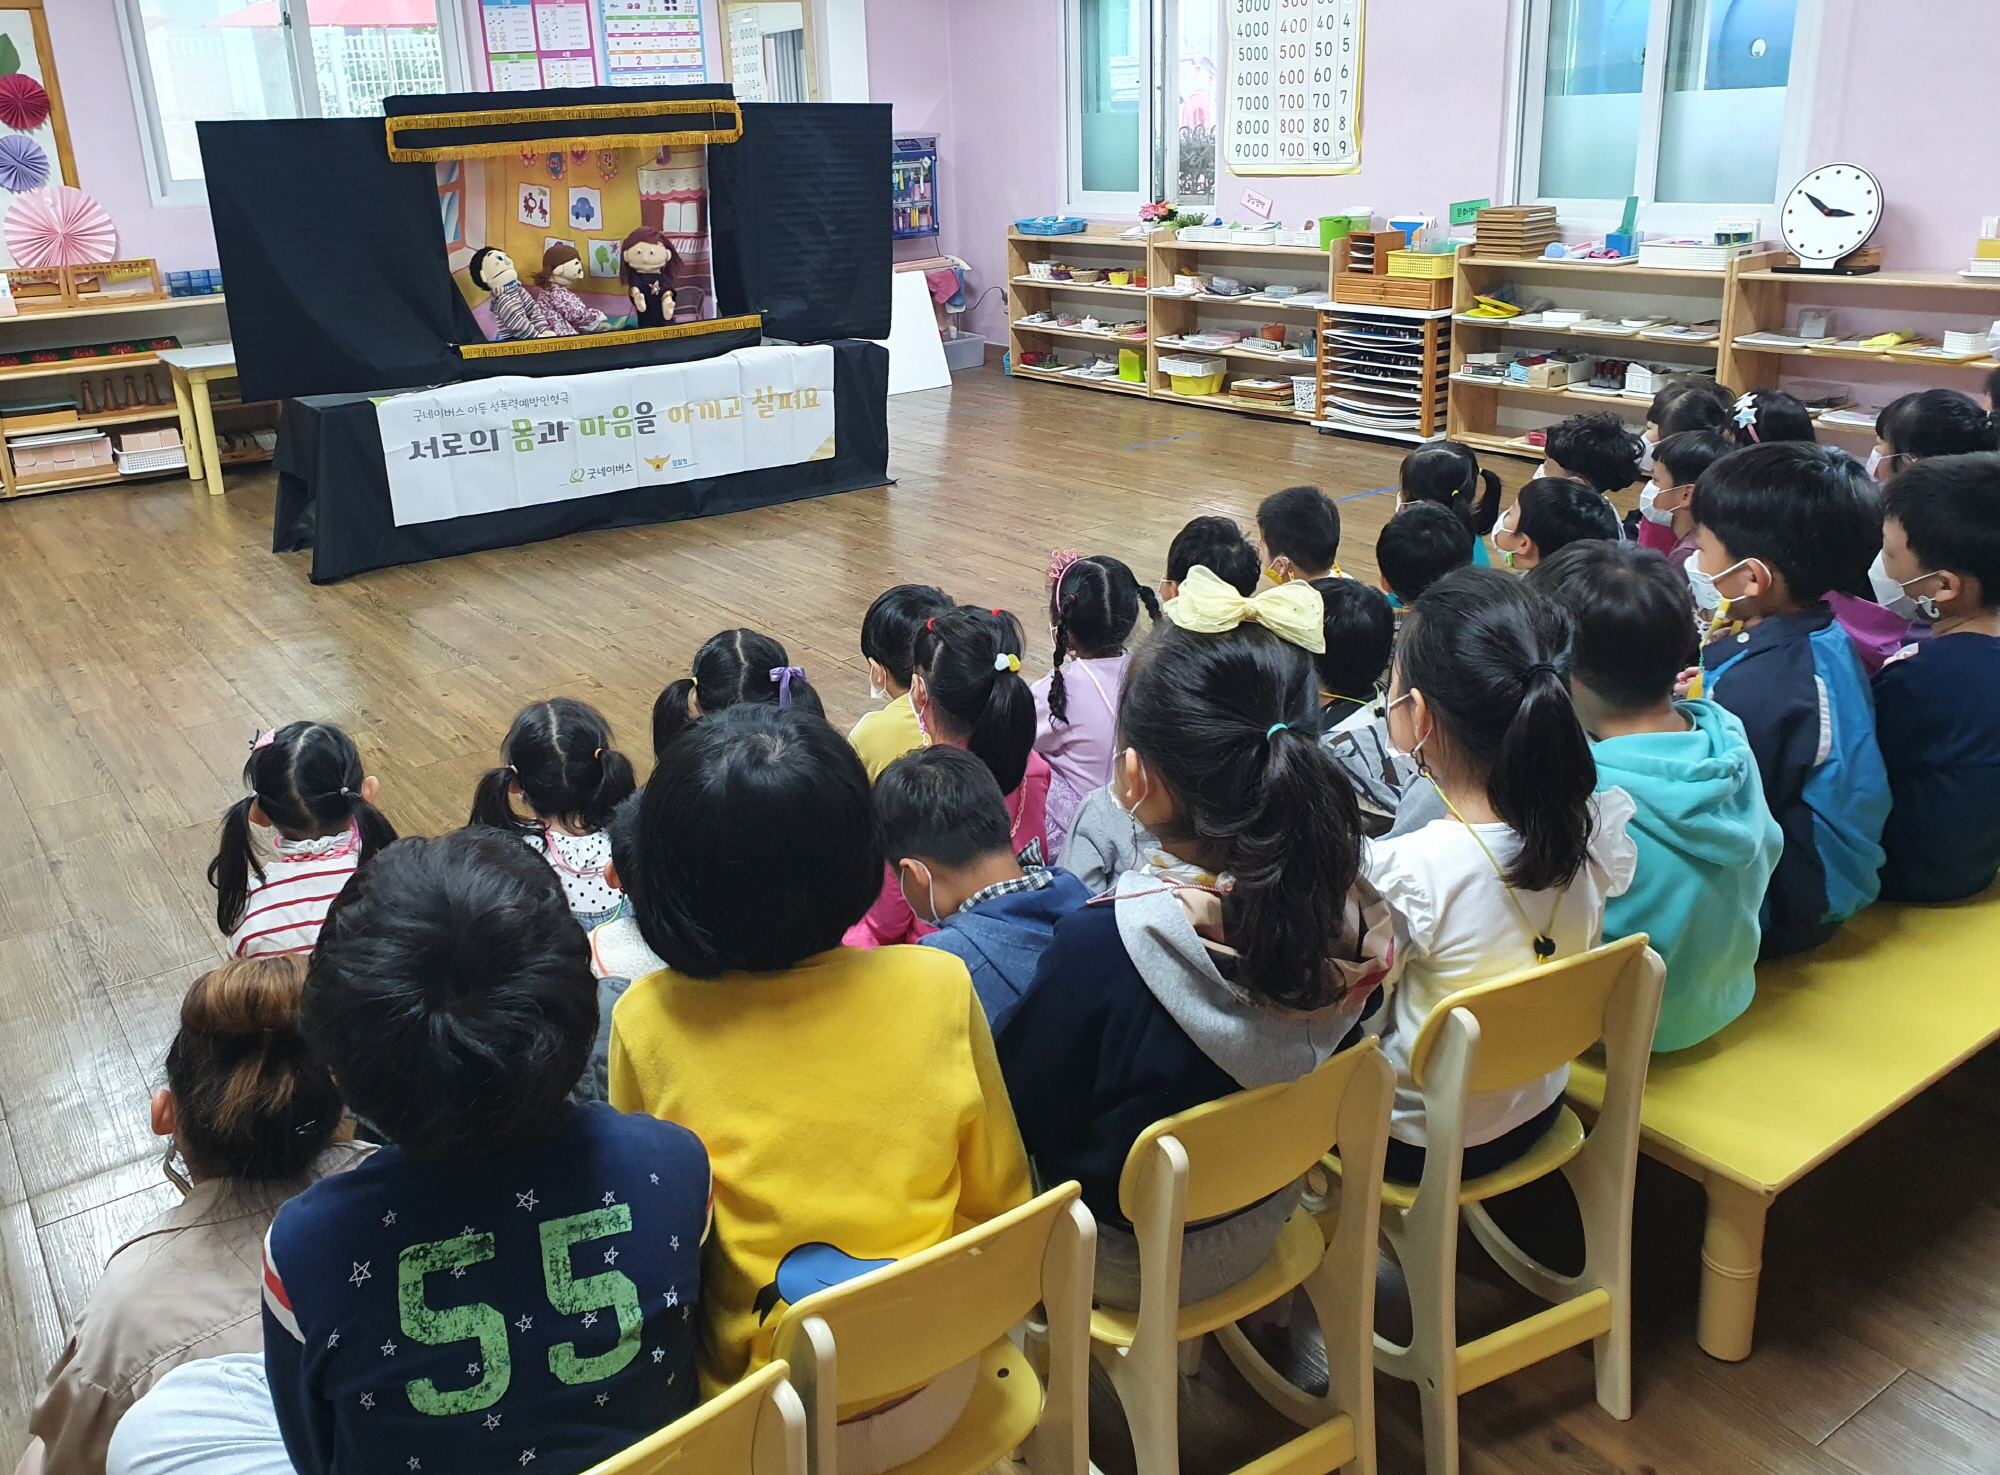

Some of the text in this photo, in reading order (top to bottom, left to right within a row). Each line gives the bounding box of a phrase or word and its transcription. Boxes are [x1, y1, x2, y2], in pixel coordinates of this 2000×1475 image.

[1237, 0, 1270, 13] 3000
[1237, 13, 1351, 38] 4000 400 40 4
[635, 55, 642, 65] 2
[654, 55, 661, 65] 3
[690, 54, 697, 64] 5
[1238, 37, 1350, 61] 5000 500 50 5
[1238, 64, 1349, 86] 6000 600 60 6
[1237, 90, 1348, 111] 7000 700 70 7
[1236, 116, 1346, 135] 8000 800 80 8
[1235, 140, 1347, 158] 9000 900 90 9
[413, 391, 570, 423] 굿네이버스 아동 성폭력예방인형극
[408, 385, 820, 460] 서로의 몸과 마음을 아끼고 살펴요
[587, 462, 634, 480] 굿네이버스
